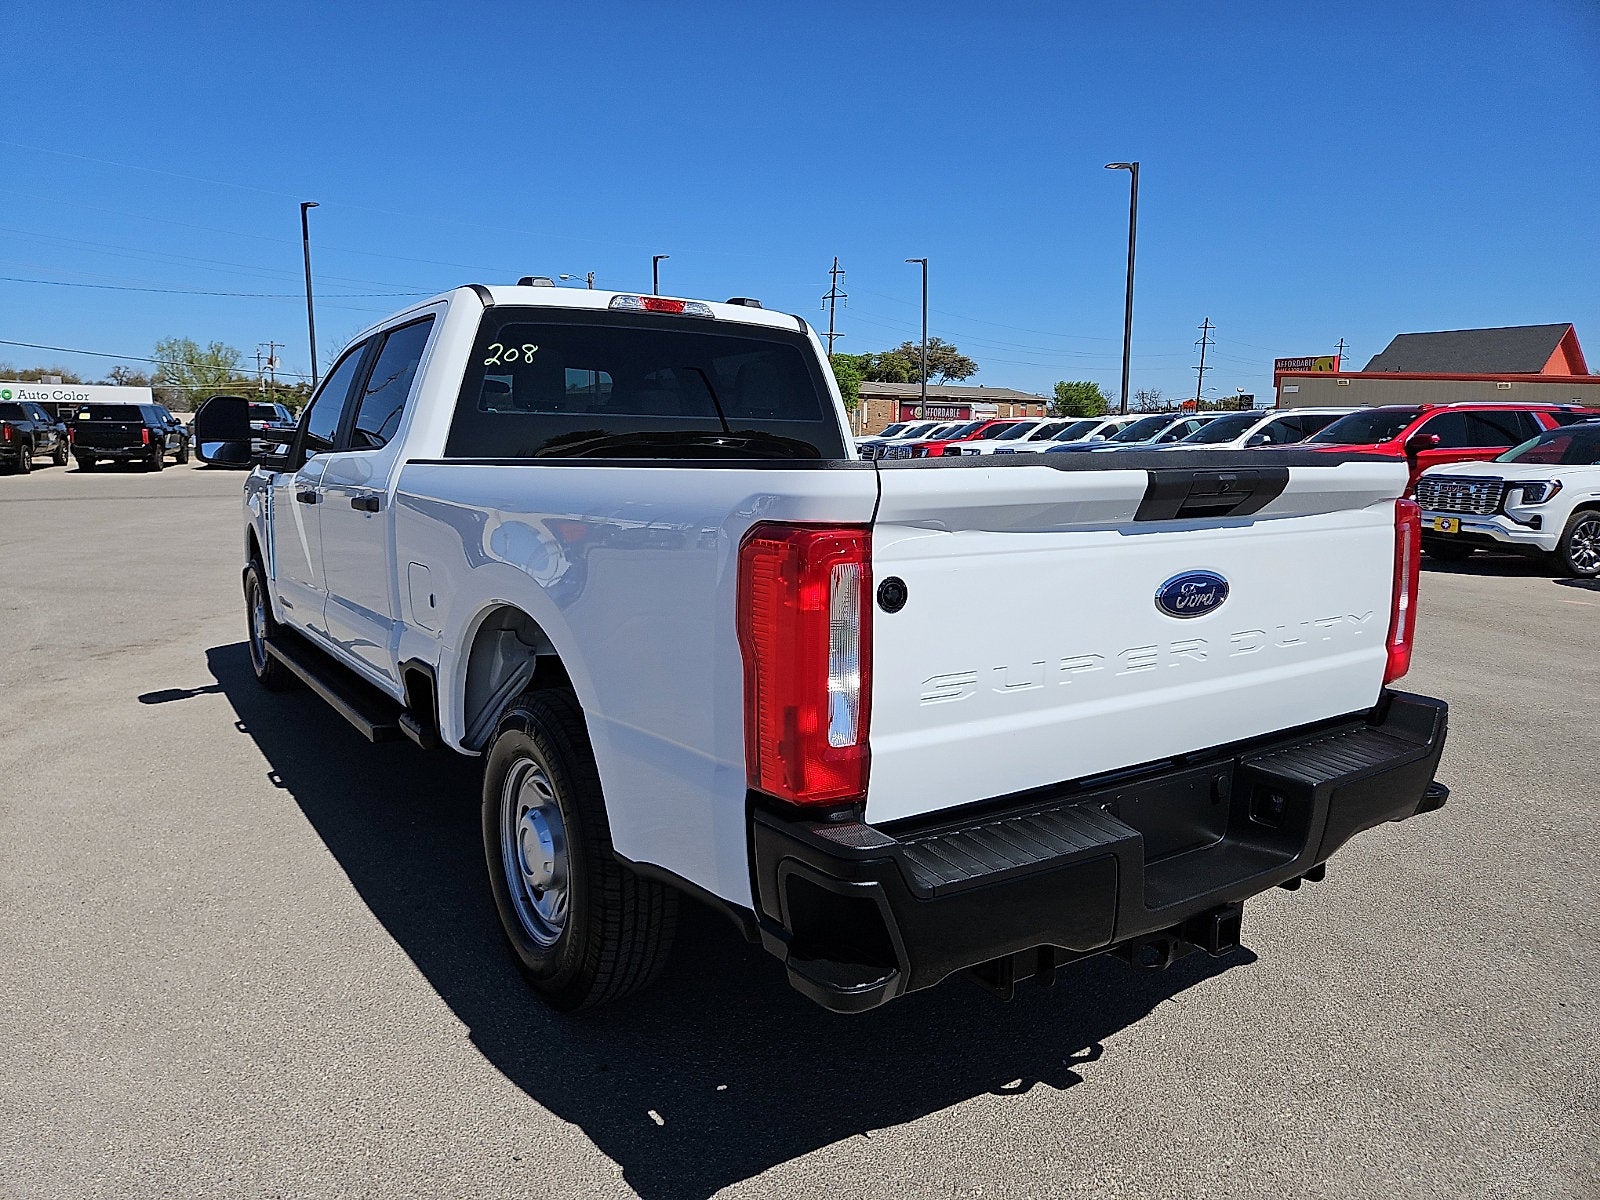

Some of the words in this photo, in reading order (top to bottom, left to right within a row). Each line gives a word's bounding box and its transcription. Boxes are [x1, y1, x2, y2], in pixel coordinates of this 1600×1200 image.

[483, 342, 539, 366] 208
[1276, 359, 1315, 368] AFFORDABLE
[17, 389, 49, 400] Auto
[52, 390, 91, 401] Color
[1175, 582, 1216, 609] Ford
[920, 638, 1209, 707] SUPER
[1229, 610, 1374, 657] DUTY
